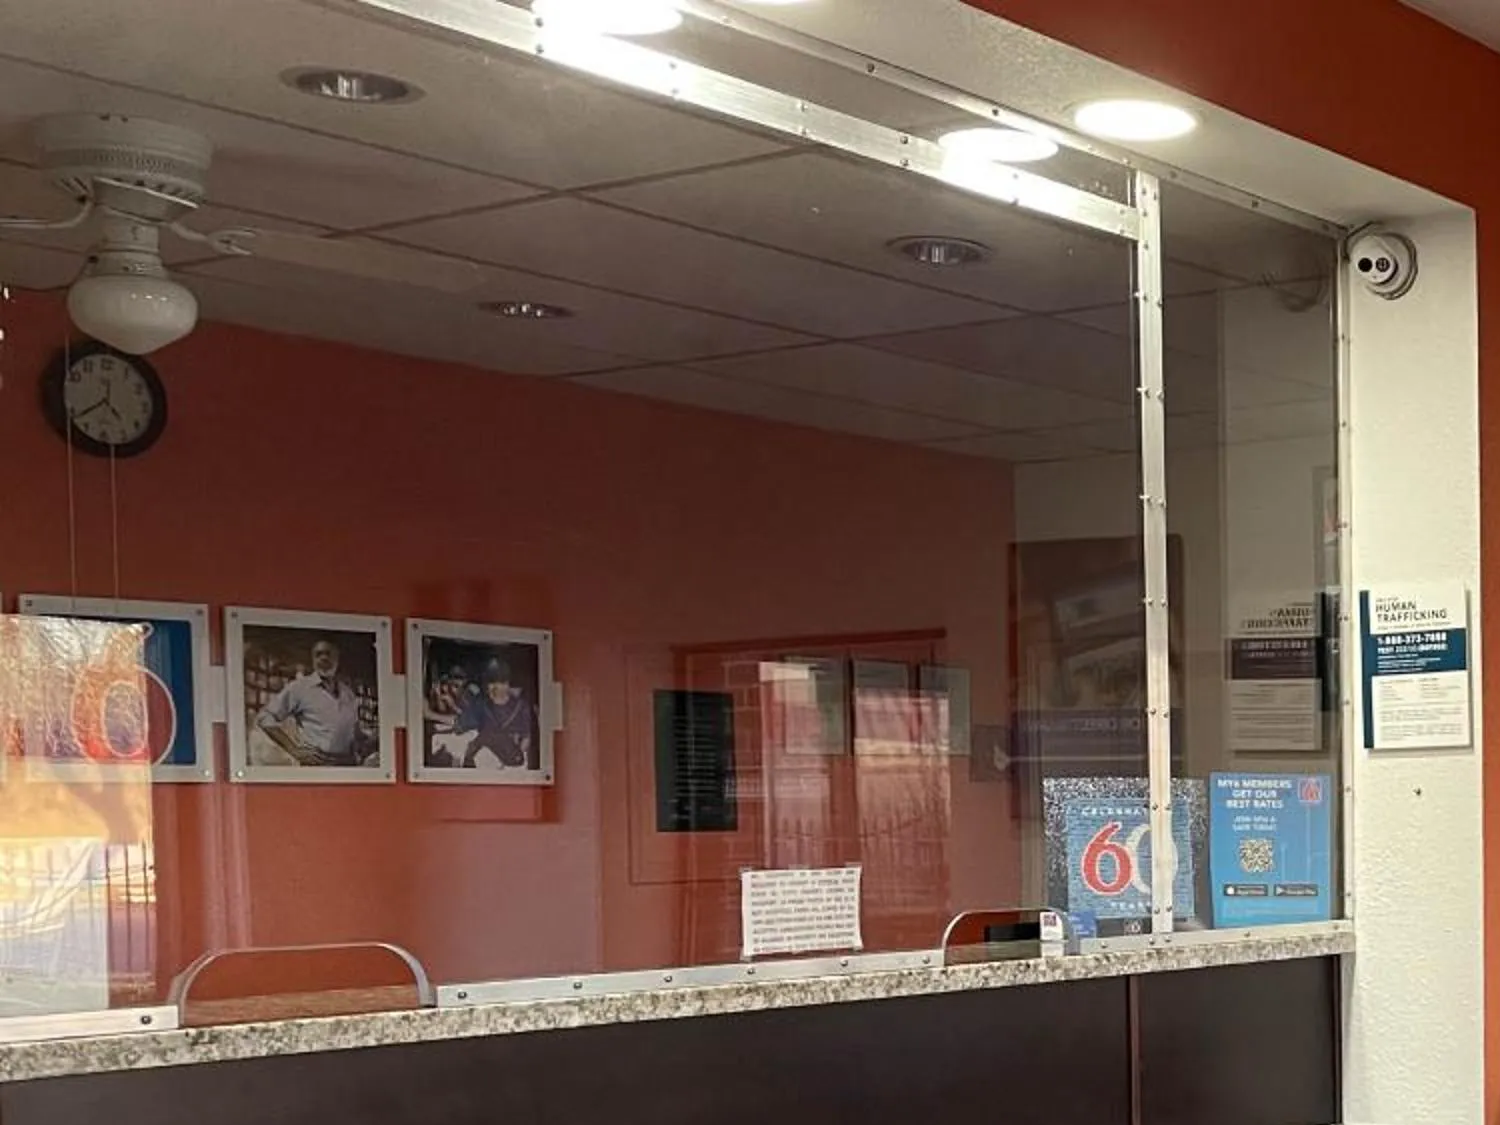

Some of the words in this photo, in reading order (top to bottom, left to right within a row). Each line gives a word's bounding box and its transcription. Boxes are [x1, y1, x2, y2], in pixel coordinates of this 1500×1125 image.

[1376, 601, 1417, 613] HUMAN
[1377, 608, 1447, 622] TRAFFICKING
[1232, 789, 1252, 799] GET
[1255, 789, 1277, 799] OUR
[1226, 799, 1250, 809] BEST
[1253, 799, 1284, 809] RATES
